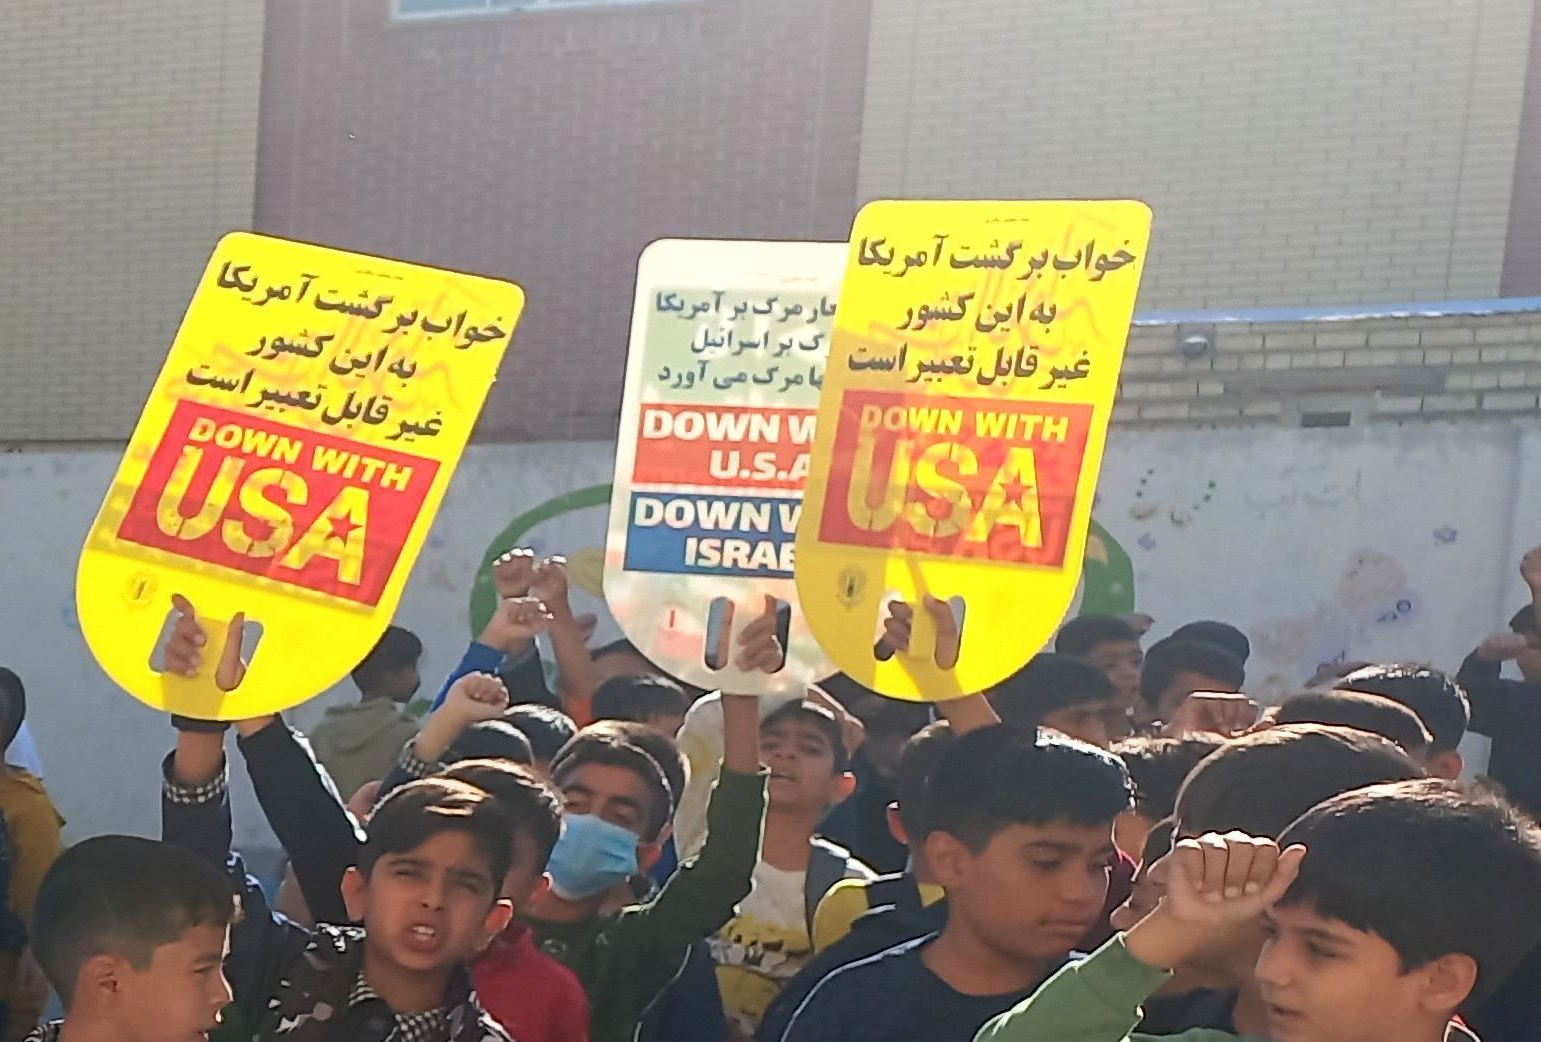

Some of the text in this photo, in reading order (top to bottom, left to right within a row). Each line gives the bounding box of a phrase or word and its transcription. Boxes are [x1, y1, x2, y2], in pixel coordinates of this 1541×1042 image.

[857, 233, 947, 278] آمریکا
[1052, 239, 1137, 283] خواب
[218, 261, 312, 307] آمریکا
[655, 290, 725, 319] آمریکا
[420, 308, 506, 350] خواب
[729, 301, 748, 320] بر
[900, 292, 1057, 333] به این کشور
[245, 328, 418, 391] به این کشور
[691, 327, 769, 354] اسرائیل
[773, 339, 792, 357] بر
[657, 360, 708, 390] آورد
[713, 371, 746, 390] می
[848, 345, 1092, 389] غیر قابل تعبیر است
[186, 362, 443, 441] غیر قابل تعبیر است
[642, 409, 780, 443] DOWN
[861, 403, 1068, 444] DOWN WITH
[189, 418, 412, 492] DOWN WITH
[847, 426, 1043, 549] USA
[157, 444, 369, 585] USA
[635, 497, 771, 532] DOWN
[684, 537, 795, 569] ISRAE
